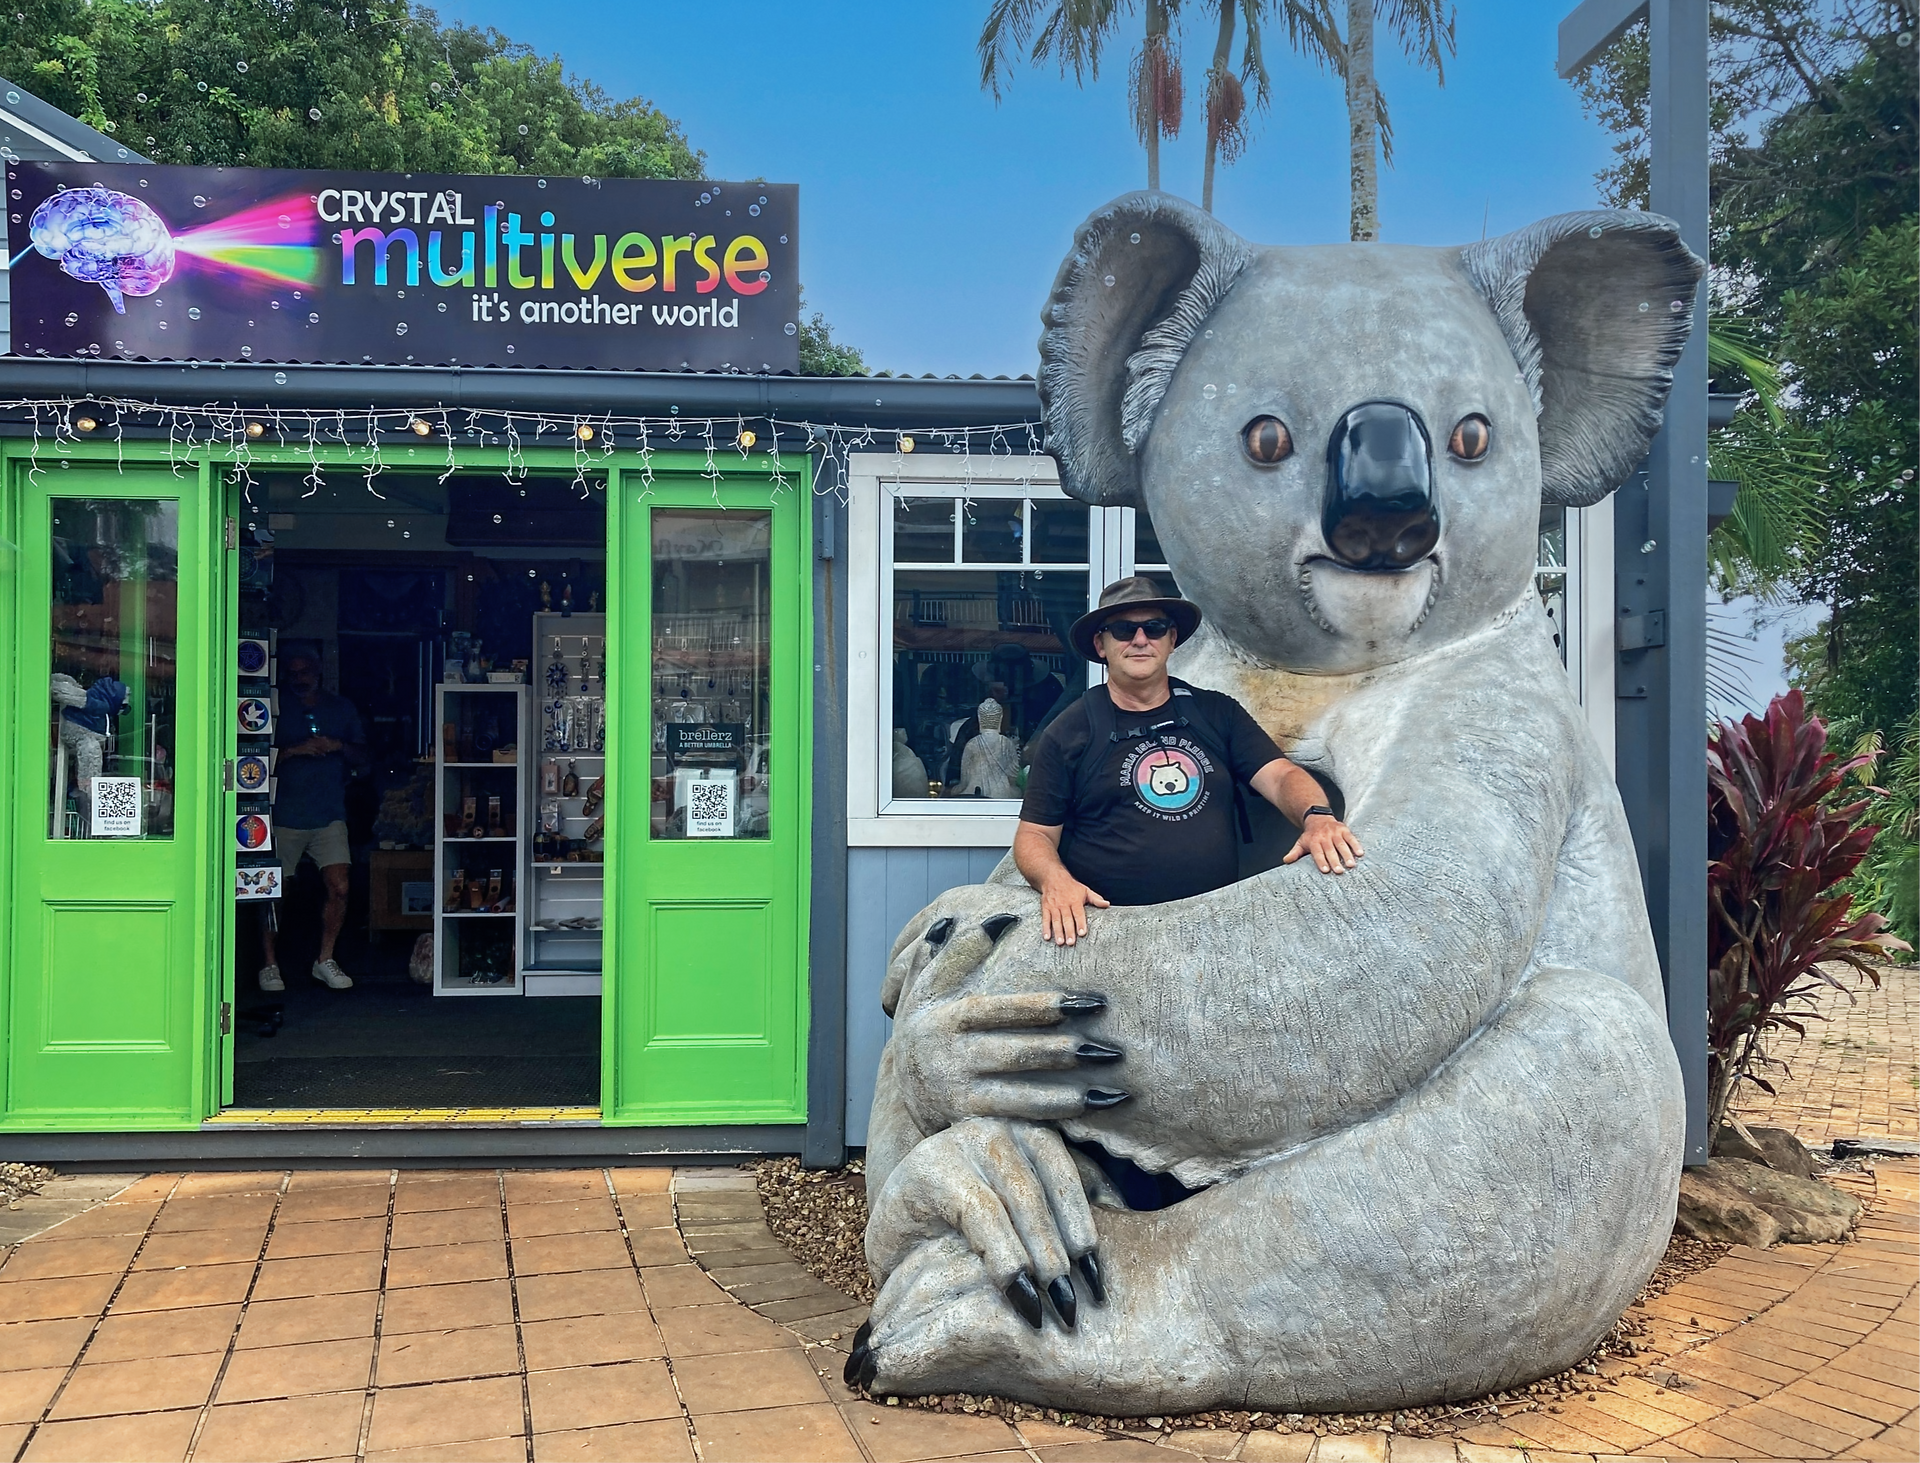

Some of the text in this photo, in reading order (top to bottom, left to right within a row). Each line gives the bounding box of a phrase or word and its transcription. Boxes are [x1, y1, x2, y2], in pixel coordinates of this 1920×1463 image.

[317, 189, 475, 225] CRYSTAL
[340, 204, 770, 296] multiverse
[472, 293, 739, 328] it's another world
[678, 729, 733, 741] brellerz
[1120, 753, 1139, 786] MARIA
[1134, 801, 1152, 814] KEEP
[1152, 811, 1161, 819] IT
[1162, 814, 1181, 822] WILD
